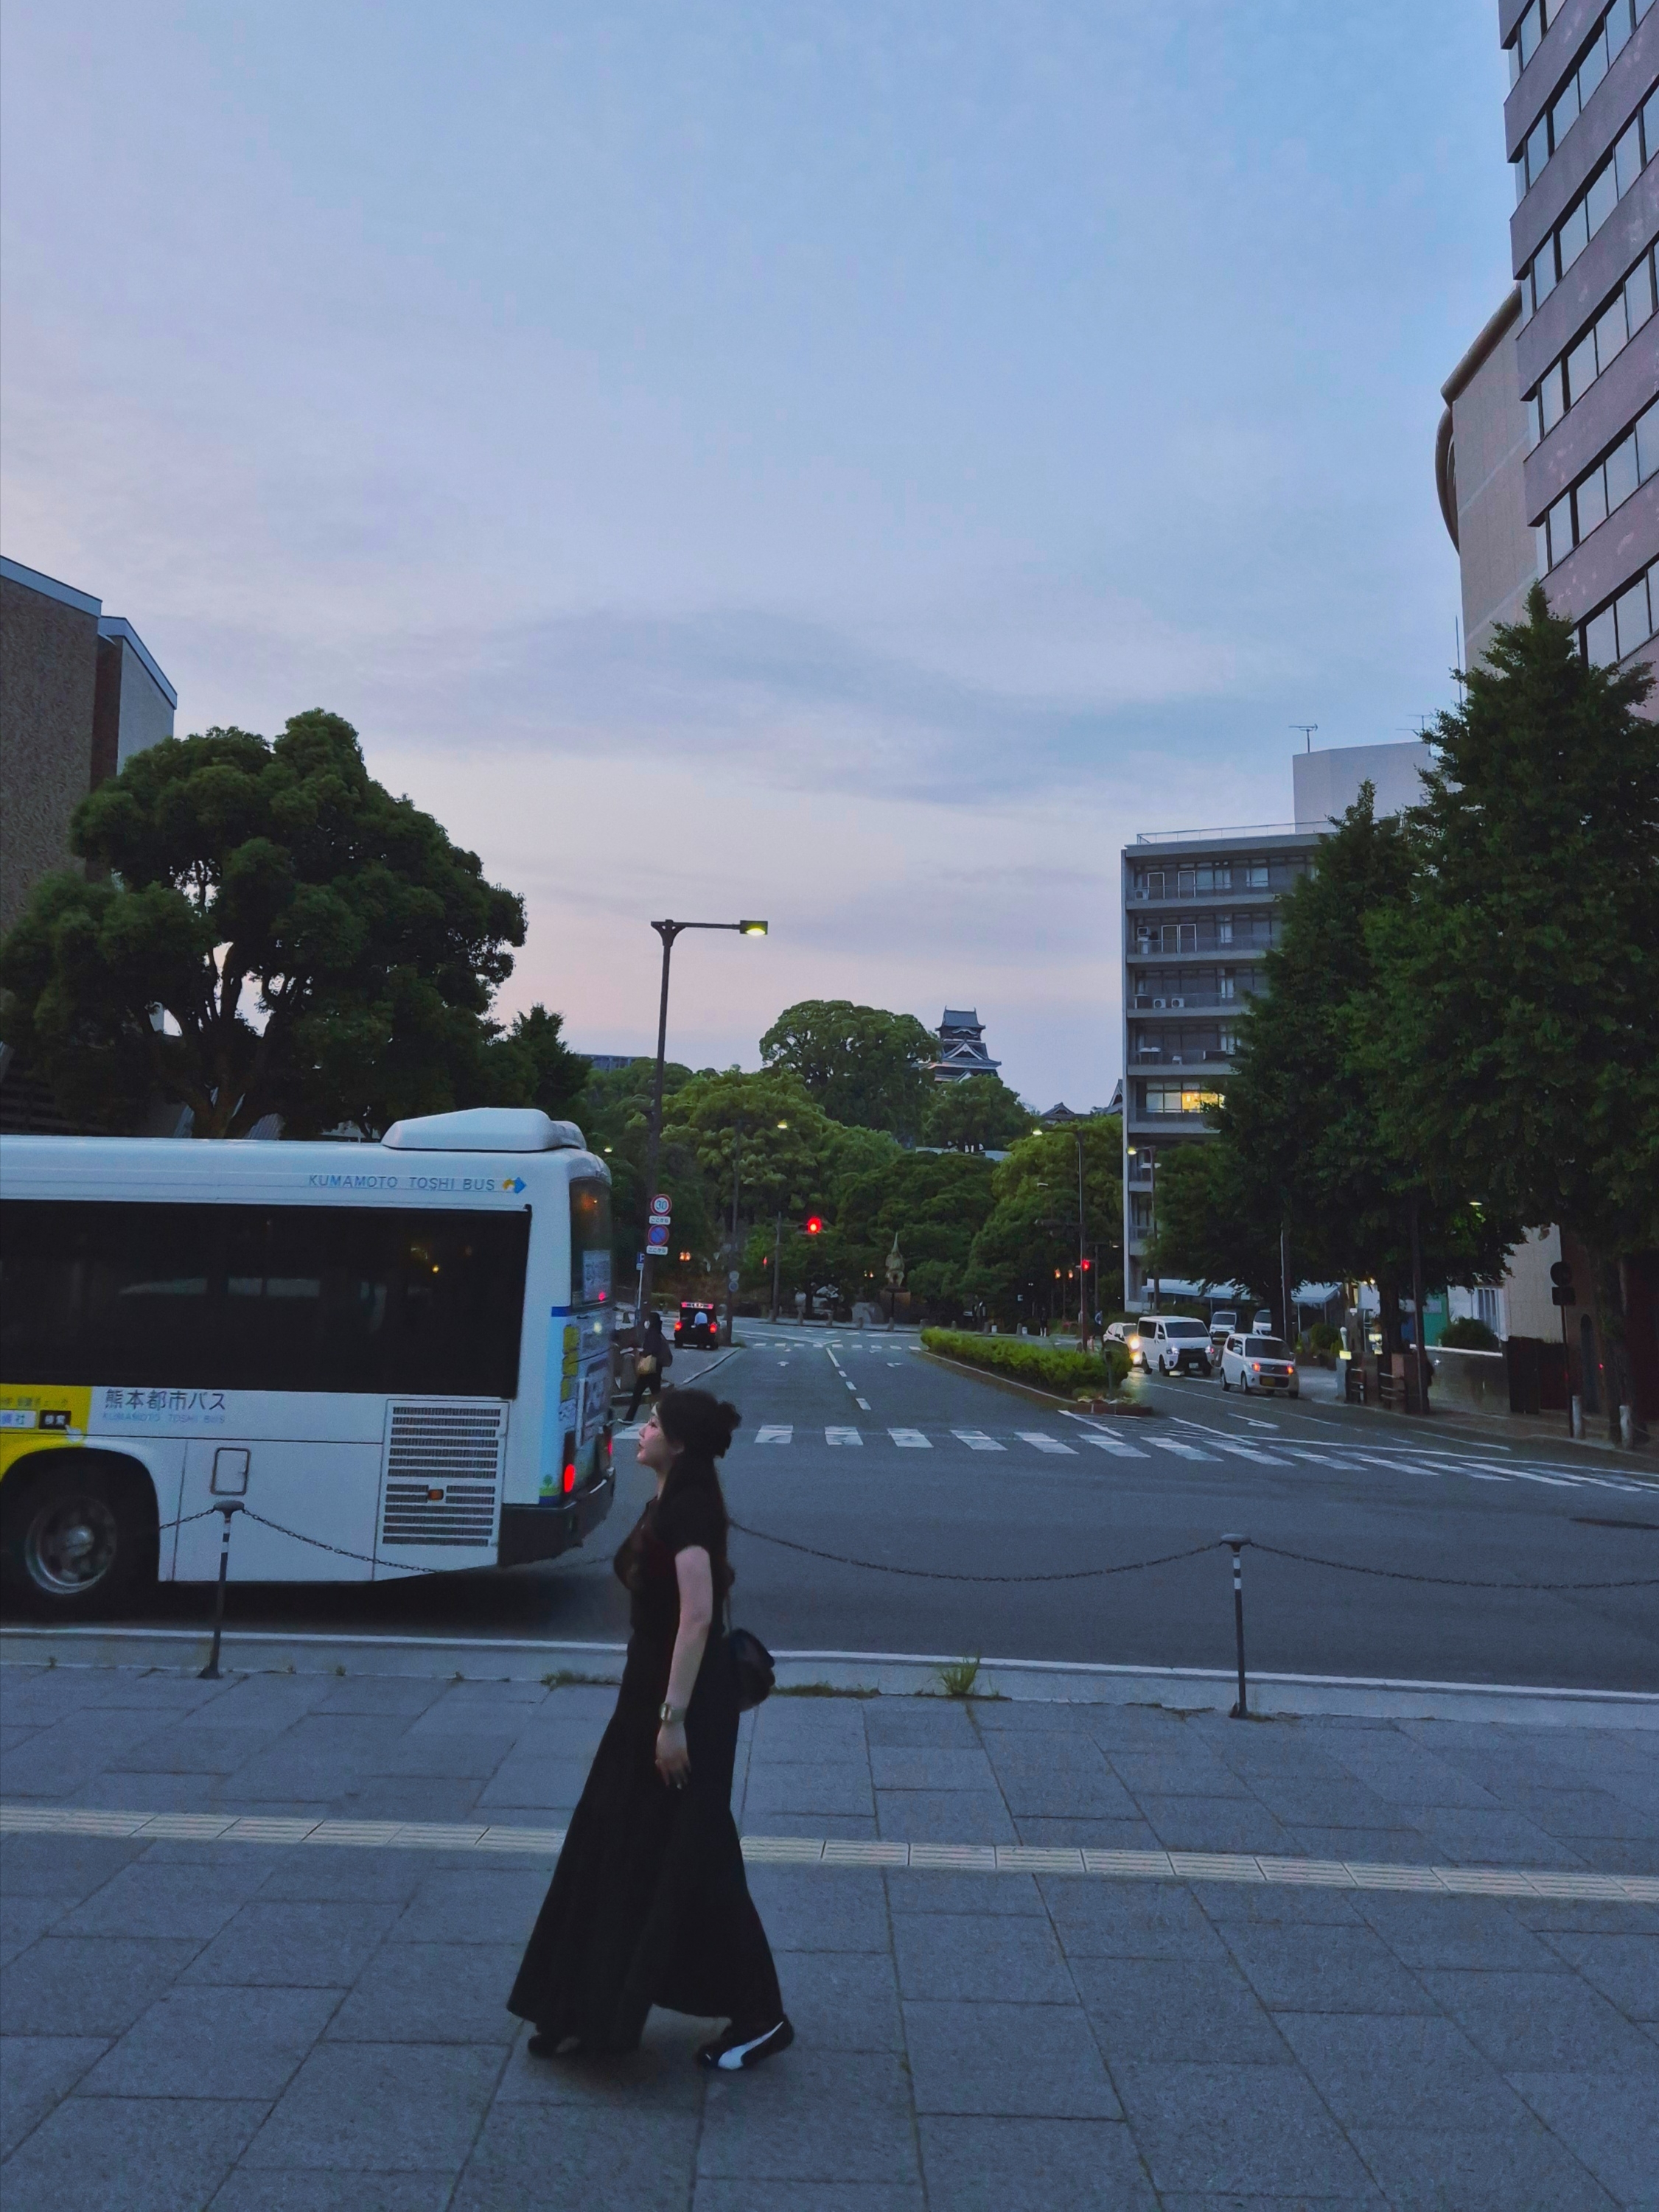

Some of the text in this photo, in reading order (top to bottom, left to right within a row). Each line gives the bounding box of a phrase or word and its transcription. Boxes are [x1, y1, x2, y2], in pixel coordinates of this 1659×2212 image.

[309, 1175, 495, 1191] KUMAMOTO TOSHI BUS
[655, 1200, 668, 1210] 30
[105, 1389, 226, 1411] 熊本都市バス
